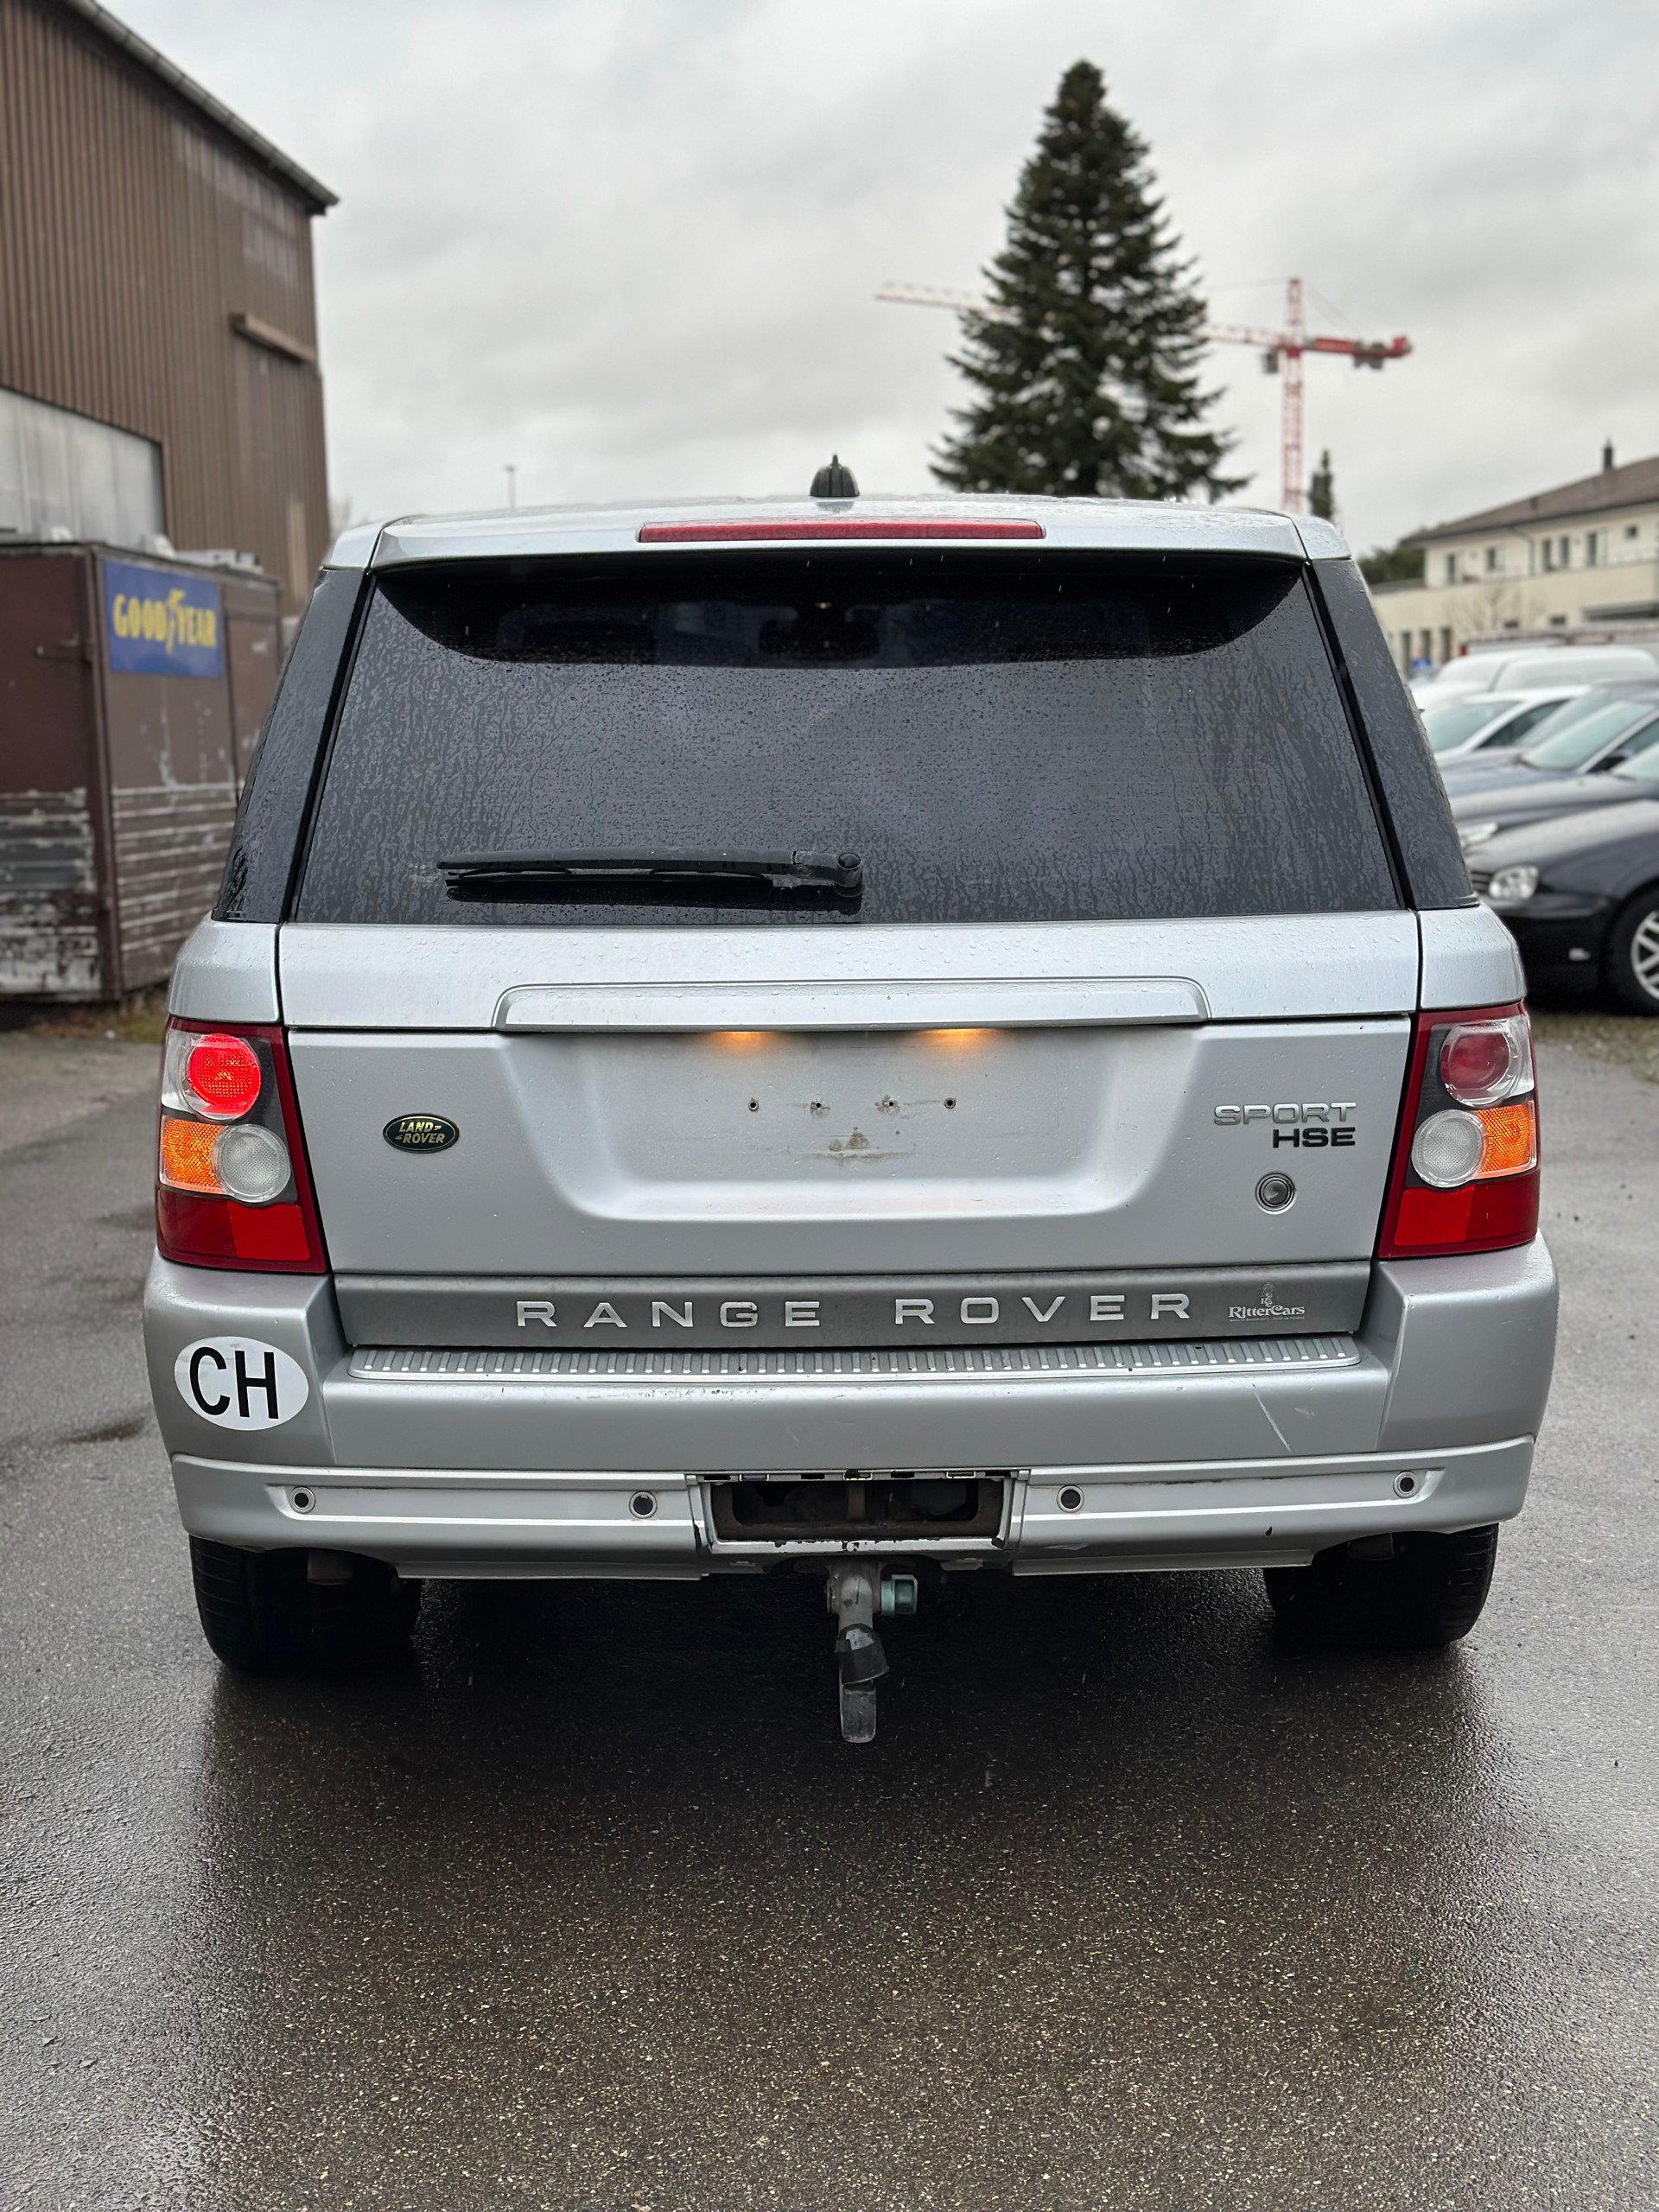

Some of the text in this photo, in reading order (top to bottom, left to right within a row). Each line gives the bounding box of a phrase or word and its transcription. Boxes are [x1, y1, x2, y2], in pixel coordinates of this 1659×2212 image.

[1214, 1102, 1357, 1125] SPORT
[399, 1122, 434, 1133] LAND
[1272, 1127, 1356, 1148] HSE
[402, 1133, 446, 1144] ROVER
[517, 1294, 1190, 1328] RANGE ROVER
[1228, 1305, 1306, 1319] RitterCars
[189, 1346, 278, 1420] CH
